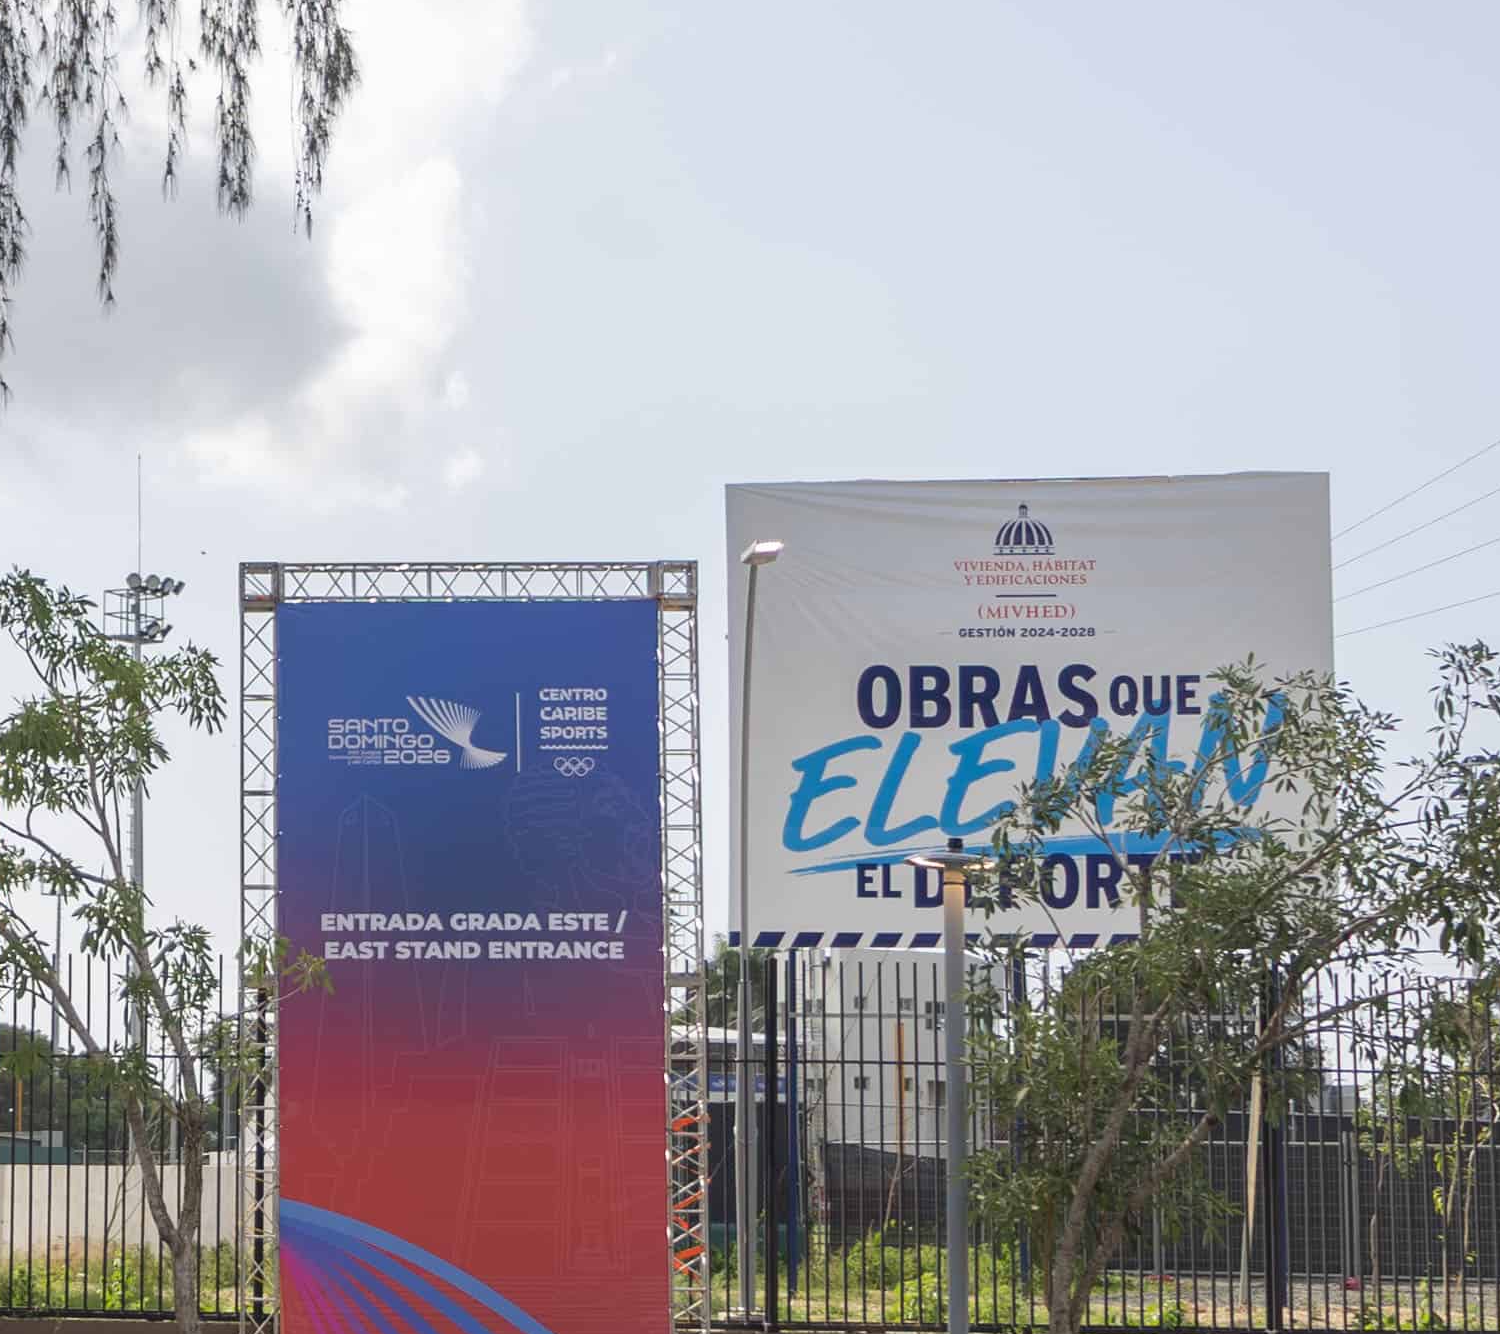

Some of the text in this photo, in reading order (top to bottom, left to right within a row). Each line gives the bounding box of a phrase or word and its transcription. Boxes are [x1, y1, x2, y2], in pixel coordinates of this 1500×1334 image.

[954, 557, 1096, 573] VIVIENDA, HÁBITAT
[964, 574, 1087, 586] Y EDIFICACIONES
[977, 603, 1077, 619] (MIVHED)
[958, 625, 1096, 638] GESTIÓN 2024-2028
[539, 688, 608, 701] CENTRO
[856, 664, 1201, 729] OBRAS QUE
[540, 706, 608, 720] CARIBE
[328, 718, 410, 734] SANTO
[540, 726, 608, 740] SPORTS
[328, 734, 434, 749] DOMINGO
[383, 749, 451, 764] 2026
[857, 863, 902, 898] EL
[320, 913, 444, 931] ENTRADA
[449, 913, 542, 931] GRADA
[548, 913, 610, 931] ESTE
[324, 941, 626, 959] EAST STAND ENTRANCE
